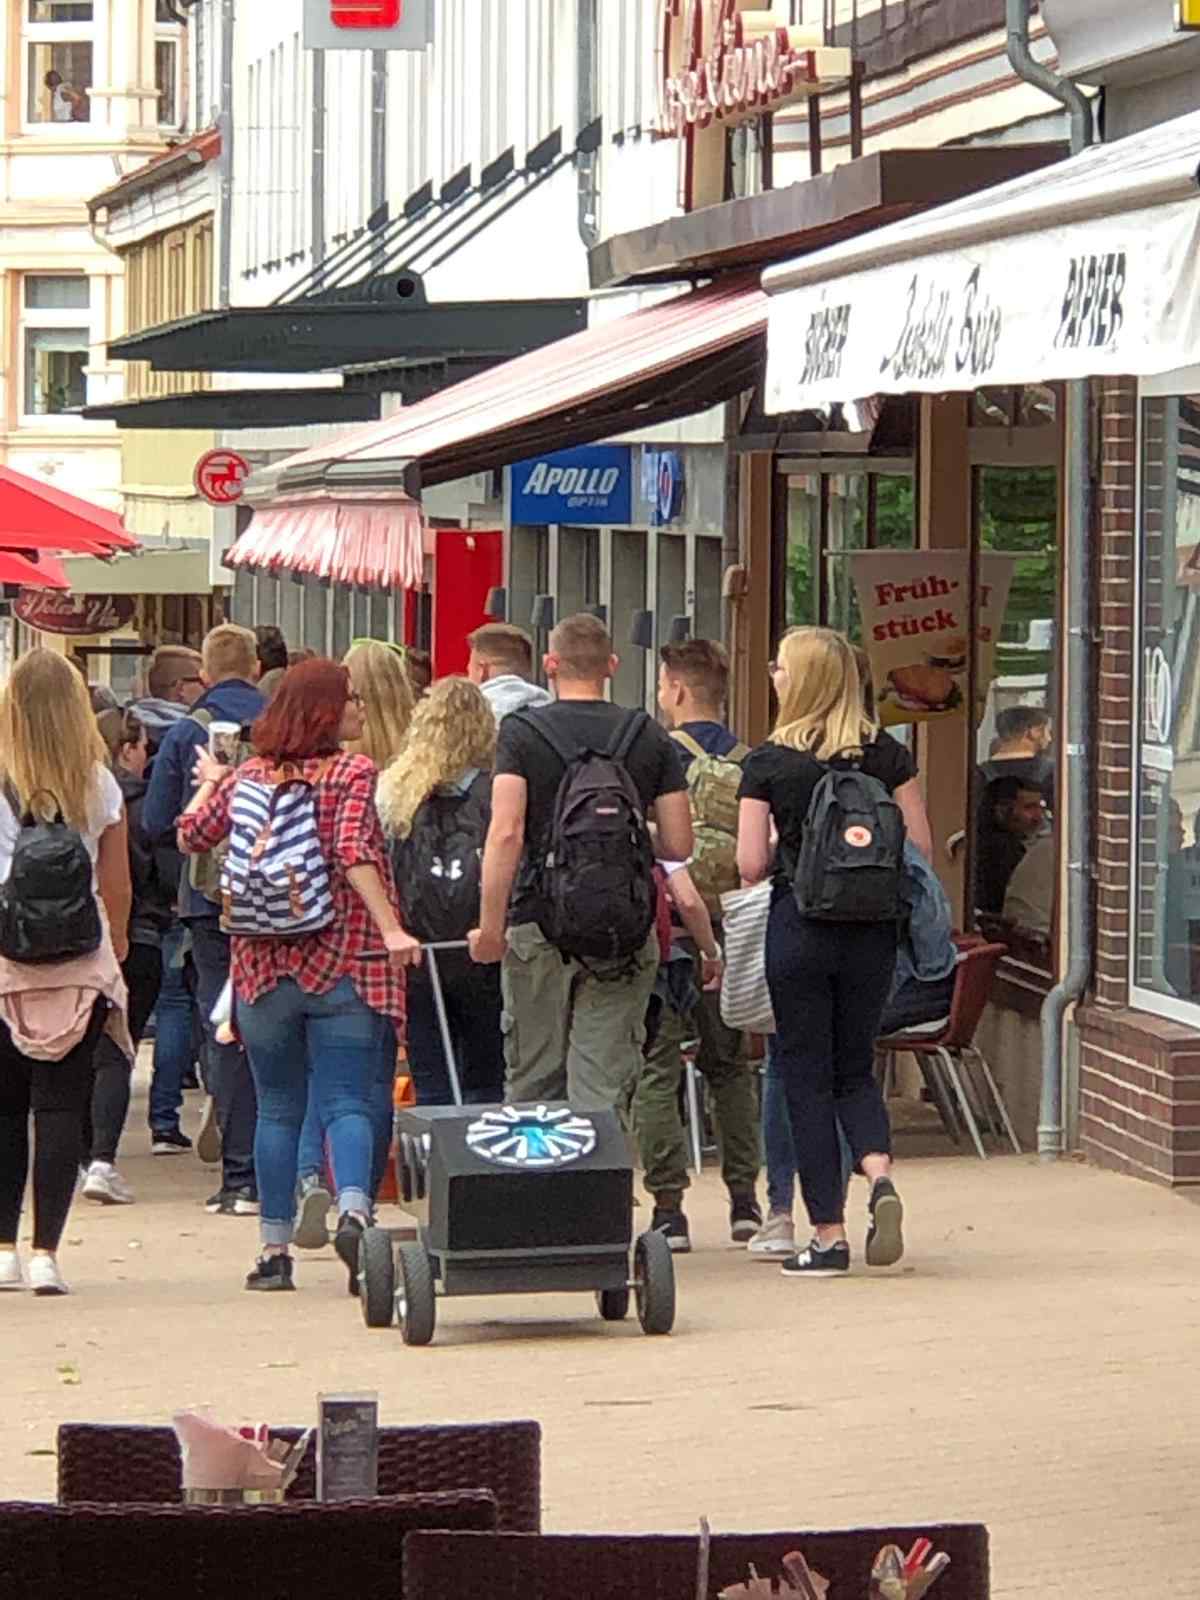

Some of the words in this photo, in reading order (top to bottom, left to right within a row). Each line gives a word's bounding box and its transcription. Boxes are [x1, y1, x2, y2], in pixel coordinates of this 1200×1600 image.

[1053, 252, 1126, 348] PAPIER
[522, 462, 620, 495] APOLLO
[874, 575, 960, 606] Früh-
[872, 608, 958, 641] stück
